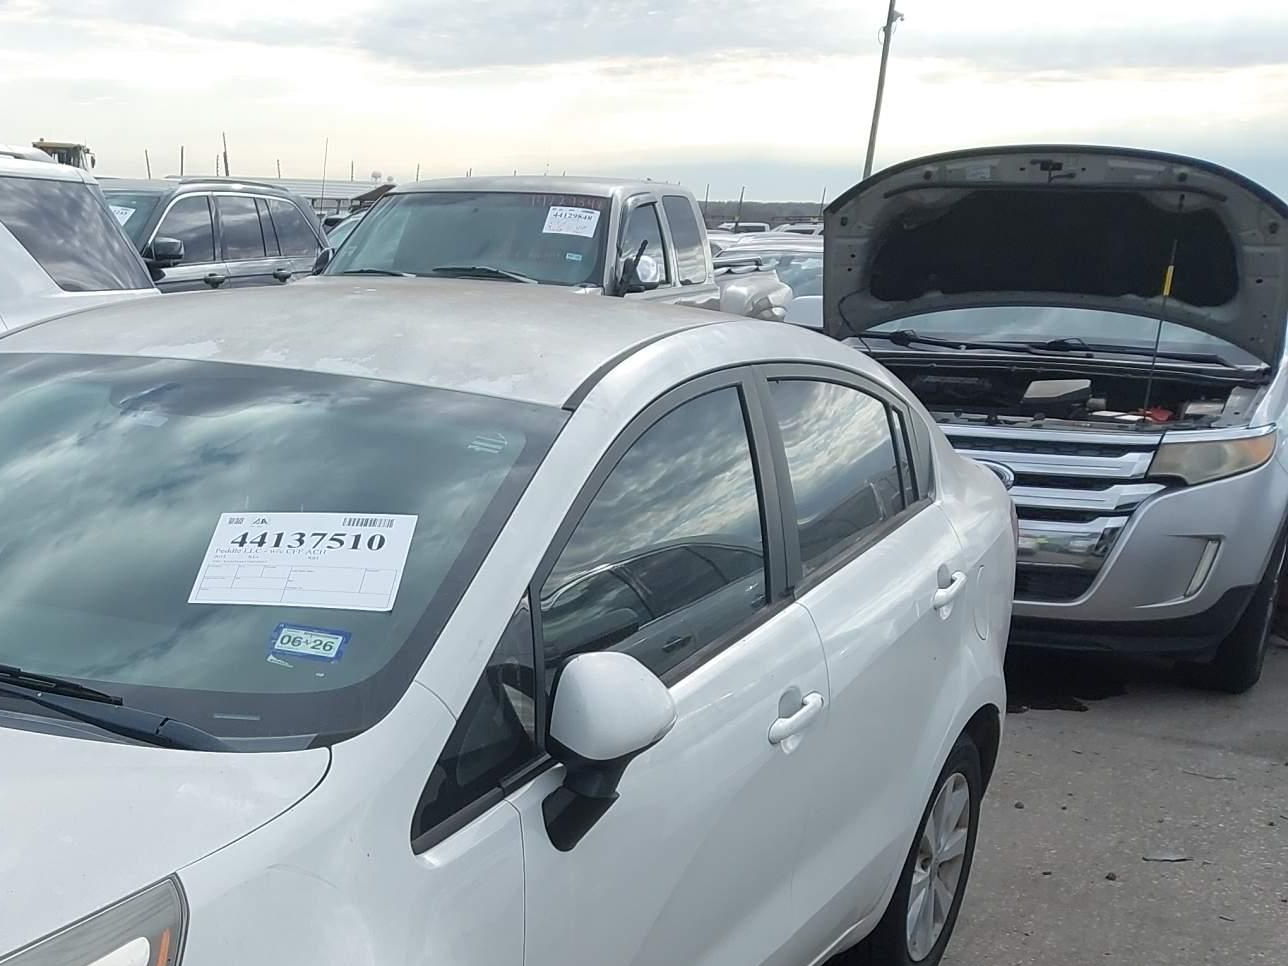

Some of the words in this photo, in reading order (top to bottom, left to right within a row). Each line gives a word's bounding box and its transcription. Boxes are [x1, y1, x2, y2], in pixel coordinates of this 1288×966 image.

[230, 531, 386, 551] 44137510
[279, 634, 303, 647] 06
[310, 638, 335, 652] 26
